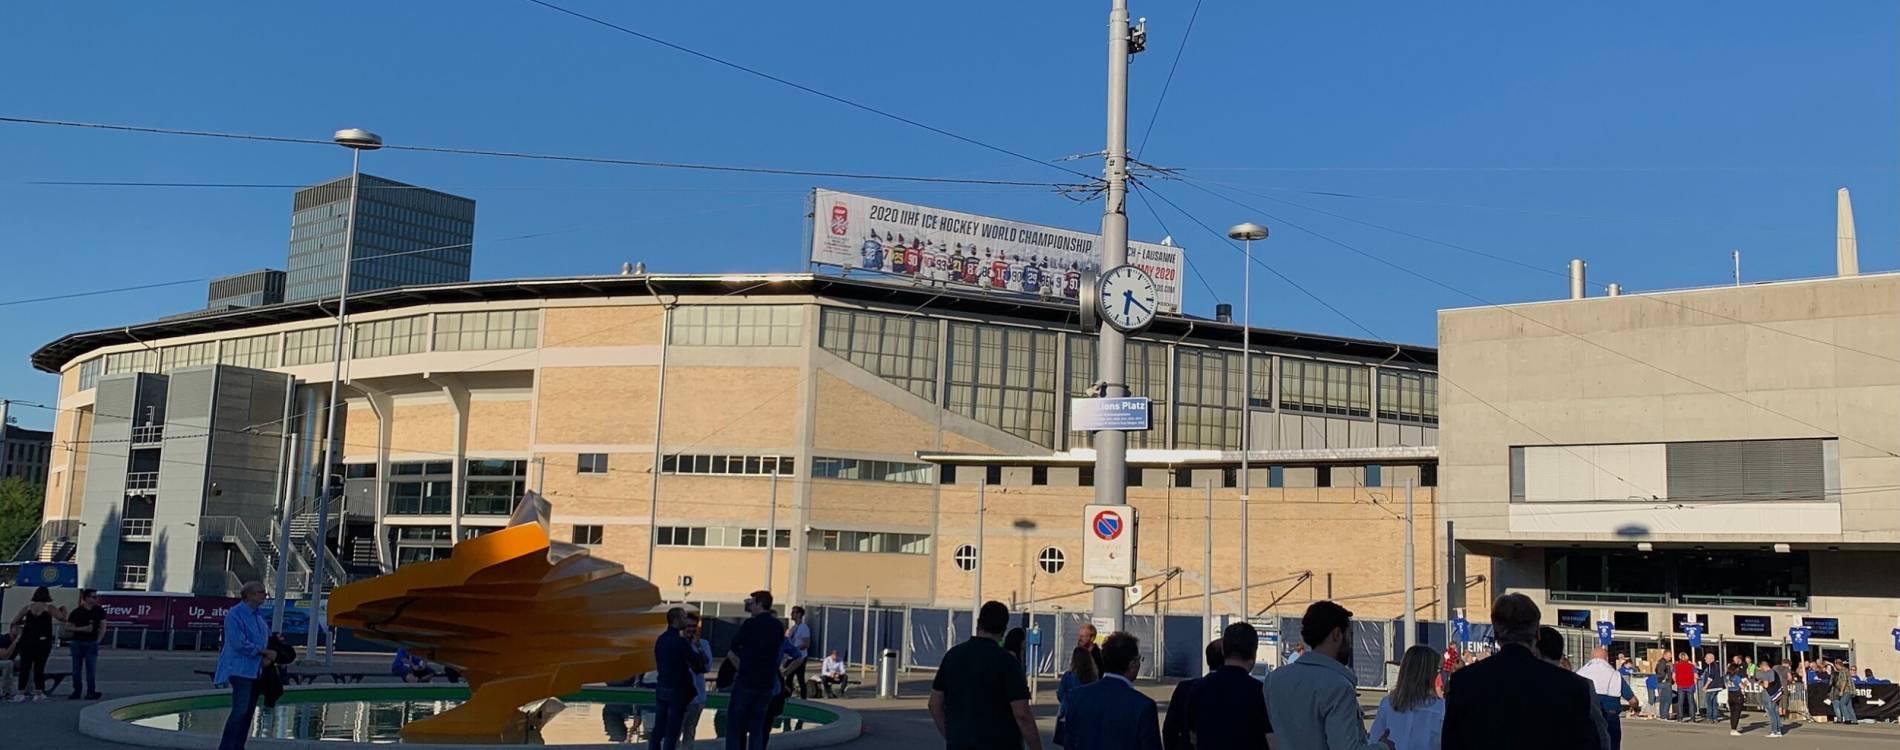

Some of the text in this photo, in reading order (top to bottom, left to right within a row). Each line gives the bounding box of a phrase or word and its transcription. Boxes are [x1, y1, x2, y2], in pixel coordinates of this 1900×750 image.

[869, 205, 1093, 253] 2020 IIHF ICE HOCKEY WORLD CHAMPIONSHIP
[1142, 249, 1176, 264] LAUSANNE
[1154, 266, 1176, 281] 2020
[1122, 401, 1145, 410] Platz
